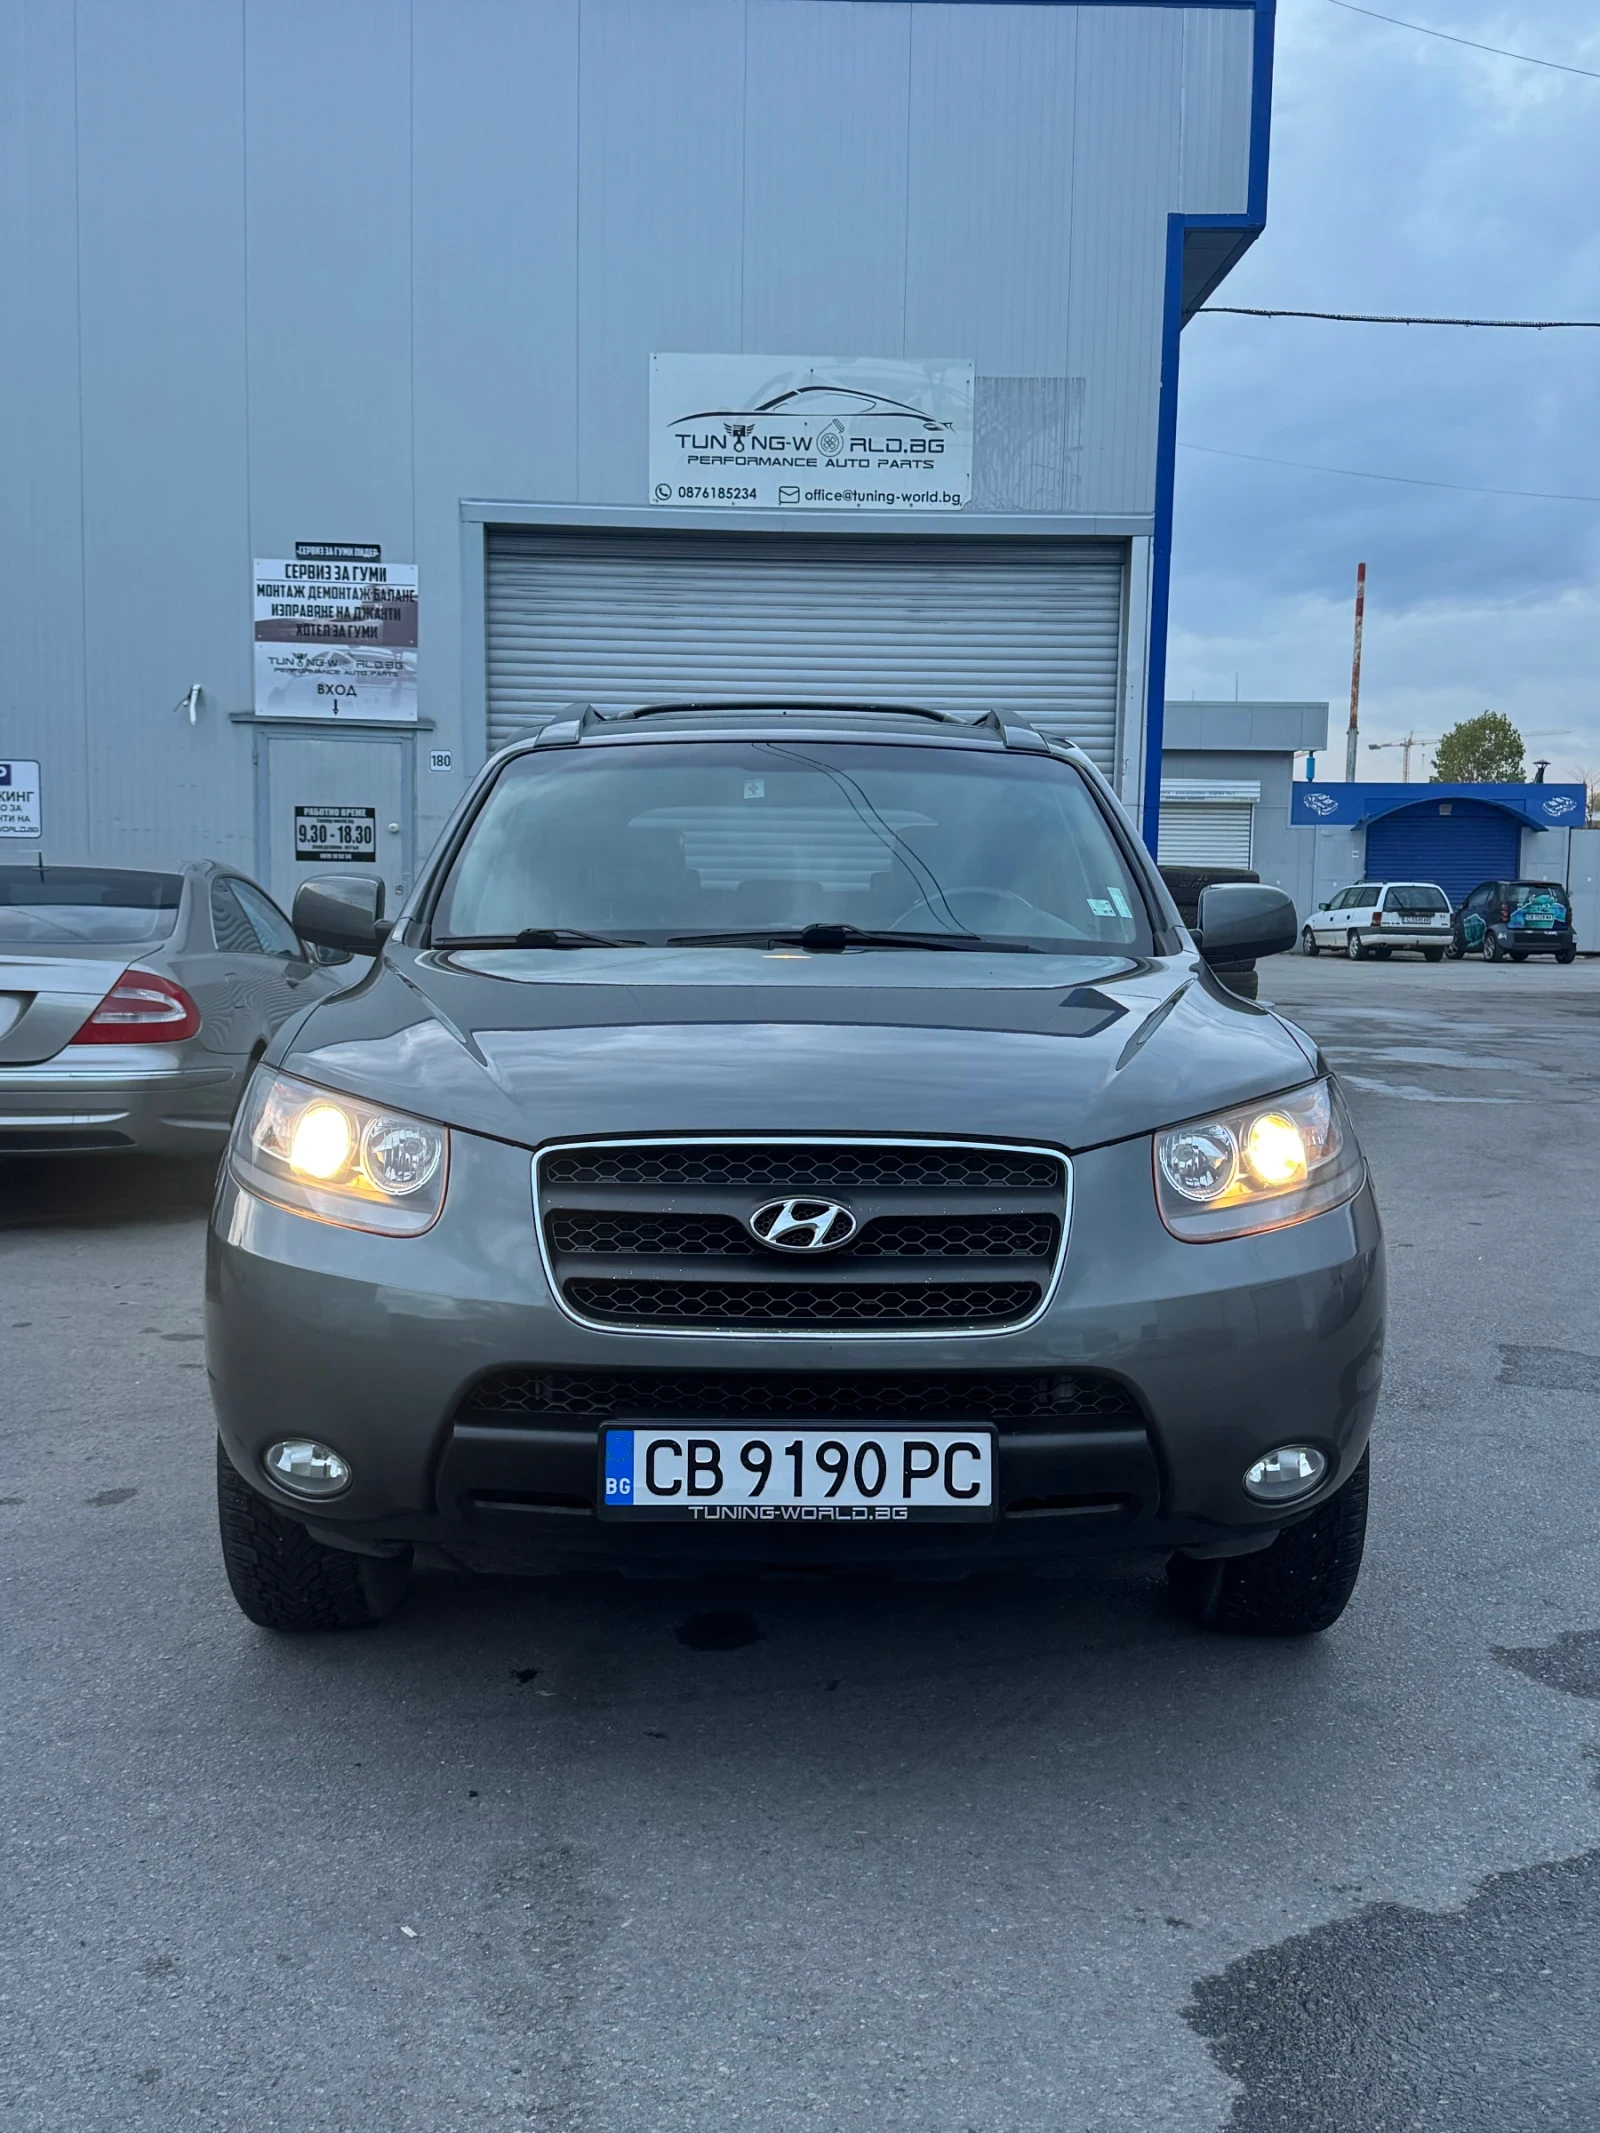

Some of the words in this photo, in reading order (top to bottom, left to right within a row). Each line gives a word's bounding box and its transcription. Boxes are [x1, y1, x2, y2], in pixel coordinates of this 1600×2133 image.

[687, 455, 818, 468] PERFORMANCE
[825, 457, 870, 469] AUTO
[877, 458, 935, 470] PARTS
[678, 486, 758, 501] 0876185234
[804, 488, 961, 506] office@tuning-world.bg
[285, 563, 331, 580] СЕРВИЗ
[334, 566, 350, 581] ЗА
[352, 566, 387, 582] ГУМИ
[256, 584, 305, 599] МОНТАЖ
[308, 586, 371, 601] ДЕМОНТАЖ
[271, 603, 334, 618] ИЗПРАВЯНЕ
[336, 606, 350, 619] НА
[353, 606, 401, 621] ДЖАНТИ
[296, 623, 331, 637] ХОТЕЛ
[333, 625, 345, 638] ЗА
[348, 625, 378, 639] ГУМИ
[274, 667, 340, 675] PERFORMANCE
[317, 684, 357, 697] ВХОД
[431, 755, 451, 767] 180
[303, 807, 340, 816] РАБОТНО
[340, 808, 367, 817] ВРЕМЕ
[299, 824, 327, 843] 9.30
[337, 825, 372, 844] 18.30
[645, 1439, 723, 1497] CB
[740, 1440, 886, 1498] 9190
[902, 1441, 981, 1499] PC
[606, 1478, 631, 1495] BG
[688, 1506, 908, 1520] TUNING-WORLD.BG
